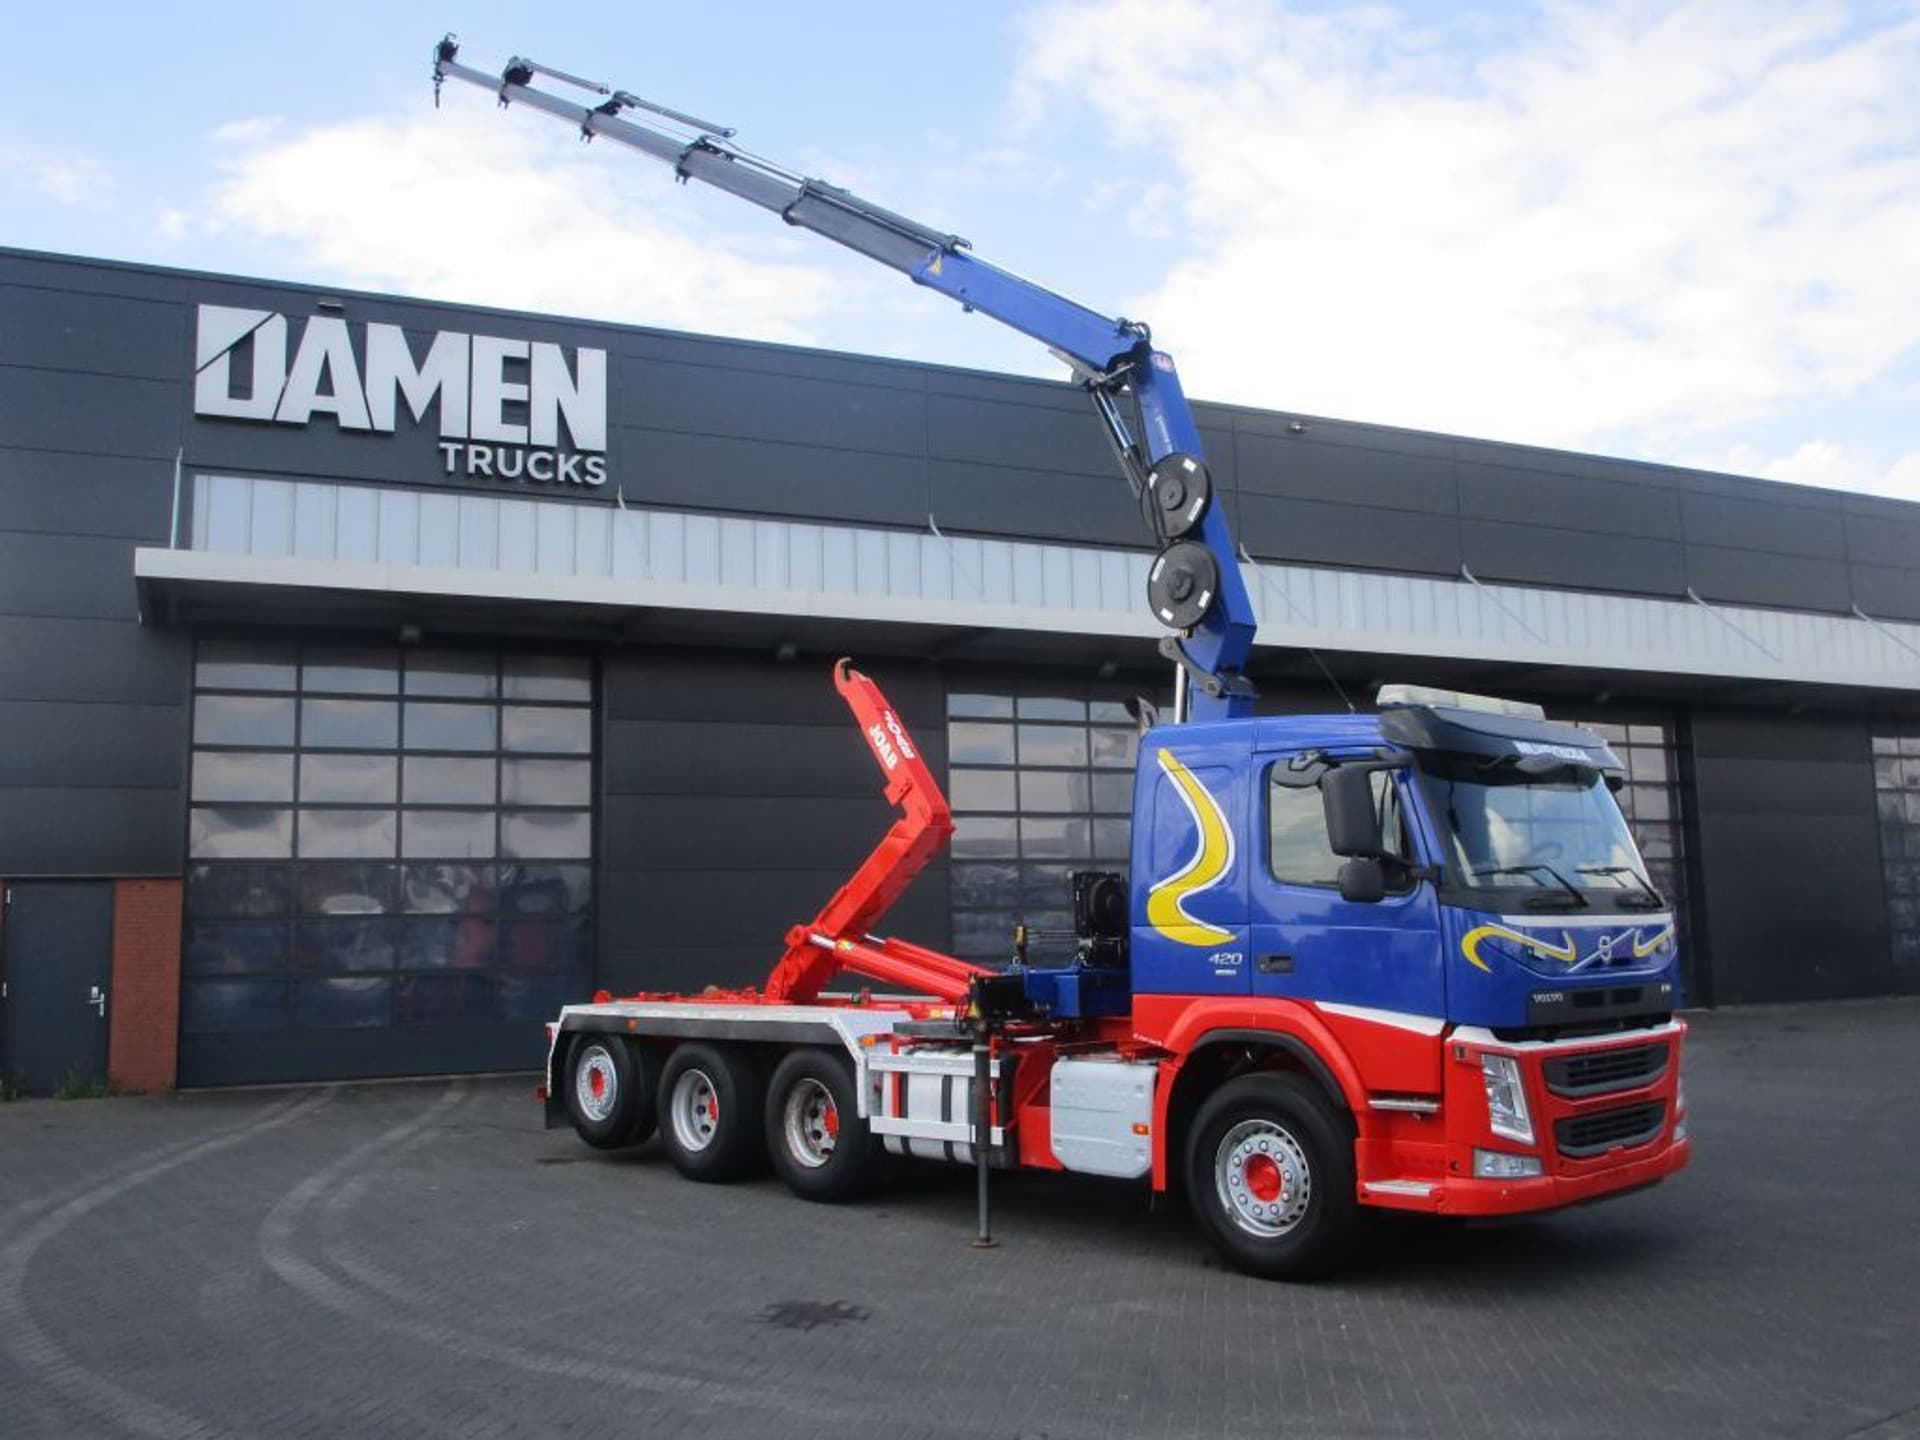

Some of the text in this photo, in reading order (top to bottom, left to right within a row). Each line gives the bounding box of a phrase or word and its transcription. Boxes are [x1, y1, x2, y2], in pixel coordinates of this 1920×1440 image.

[195, 303, 608, 452] DAMEN
[439, 441, 608, 486] TRUCKS
[1208, 952, 1243, 966] 420
